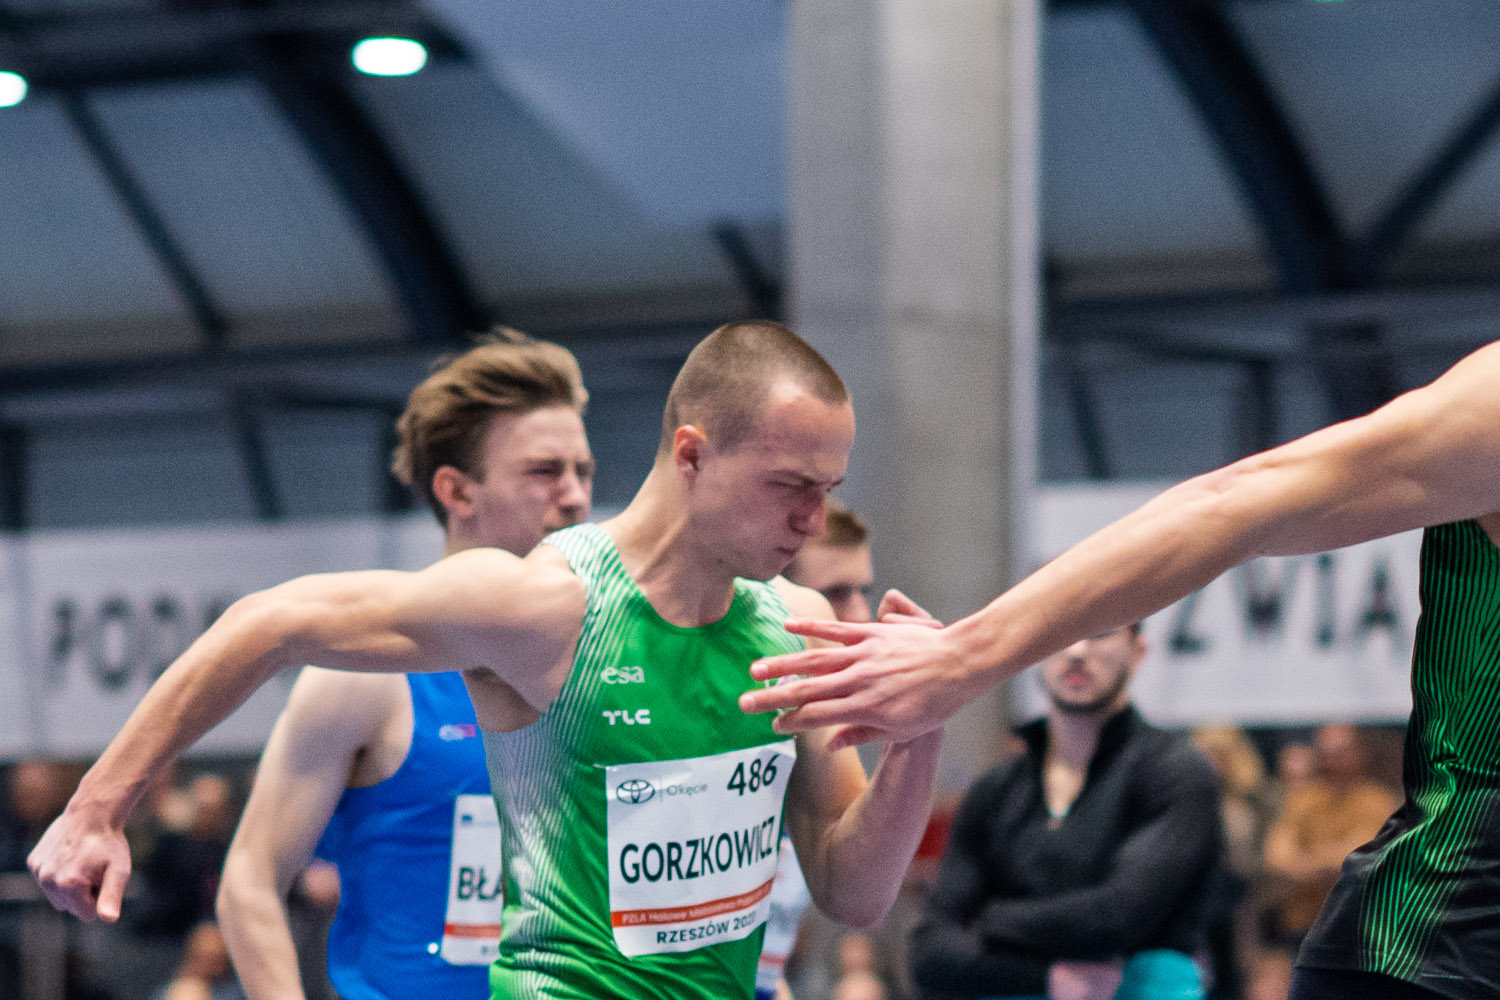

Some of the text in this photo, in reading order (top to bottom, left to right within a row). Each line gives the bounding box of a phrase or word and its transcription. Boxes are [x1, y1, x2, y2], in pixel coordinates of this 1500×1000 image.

[601, 665, 645, 685] esa
[602, 708, 651, 726] TLC
[727, 754, 780, 797] 486
[619, 815, 775, 884] GORZKOWICZ
[656, 921, 730, 945] RZESZÓW
